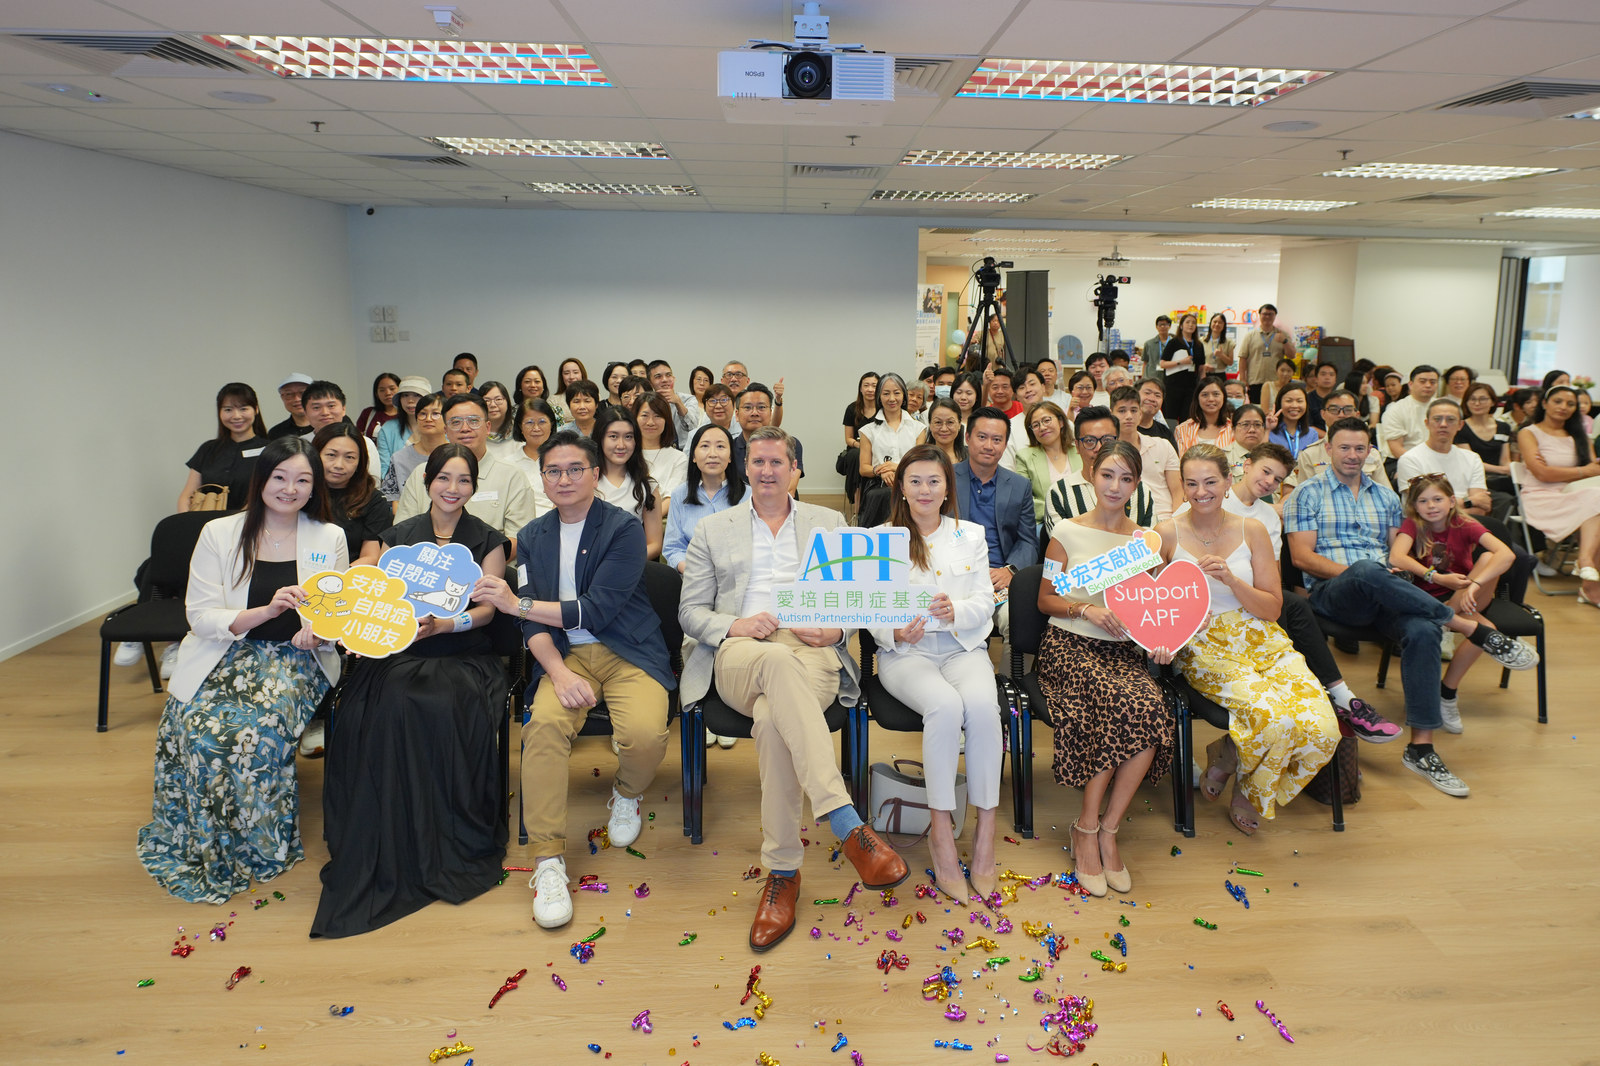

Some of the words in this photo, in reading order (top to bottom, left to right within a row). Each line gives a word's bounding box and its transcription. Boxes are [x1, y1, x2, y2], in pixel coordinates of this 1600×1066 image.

[416, 545, 455, 571] 關注
[798, 532, 905, 582] APF
[347, 574, 388, 598] 支持
[384, 558, 441, 589] 自閉症
[1087, 572, 1124, 594] Skyline
[1124, 555, 1161, 577] Takeoff
[776, 590, 934, 609] 愛培自閉症基金
[1114, 581, 1200, 605] Support
[352, 597, 411, 627] 自閉症
[776, 612, 811, 623] Autism
[814, 612, 871, 625] Partnership
[874, 612, 933, 623] Foundaton
[1140, 608, 1180, 627] APF
[341, 618, 401, 649] 小朋友
